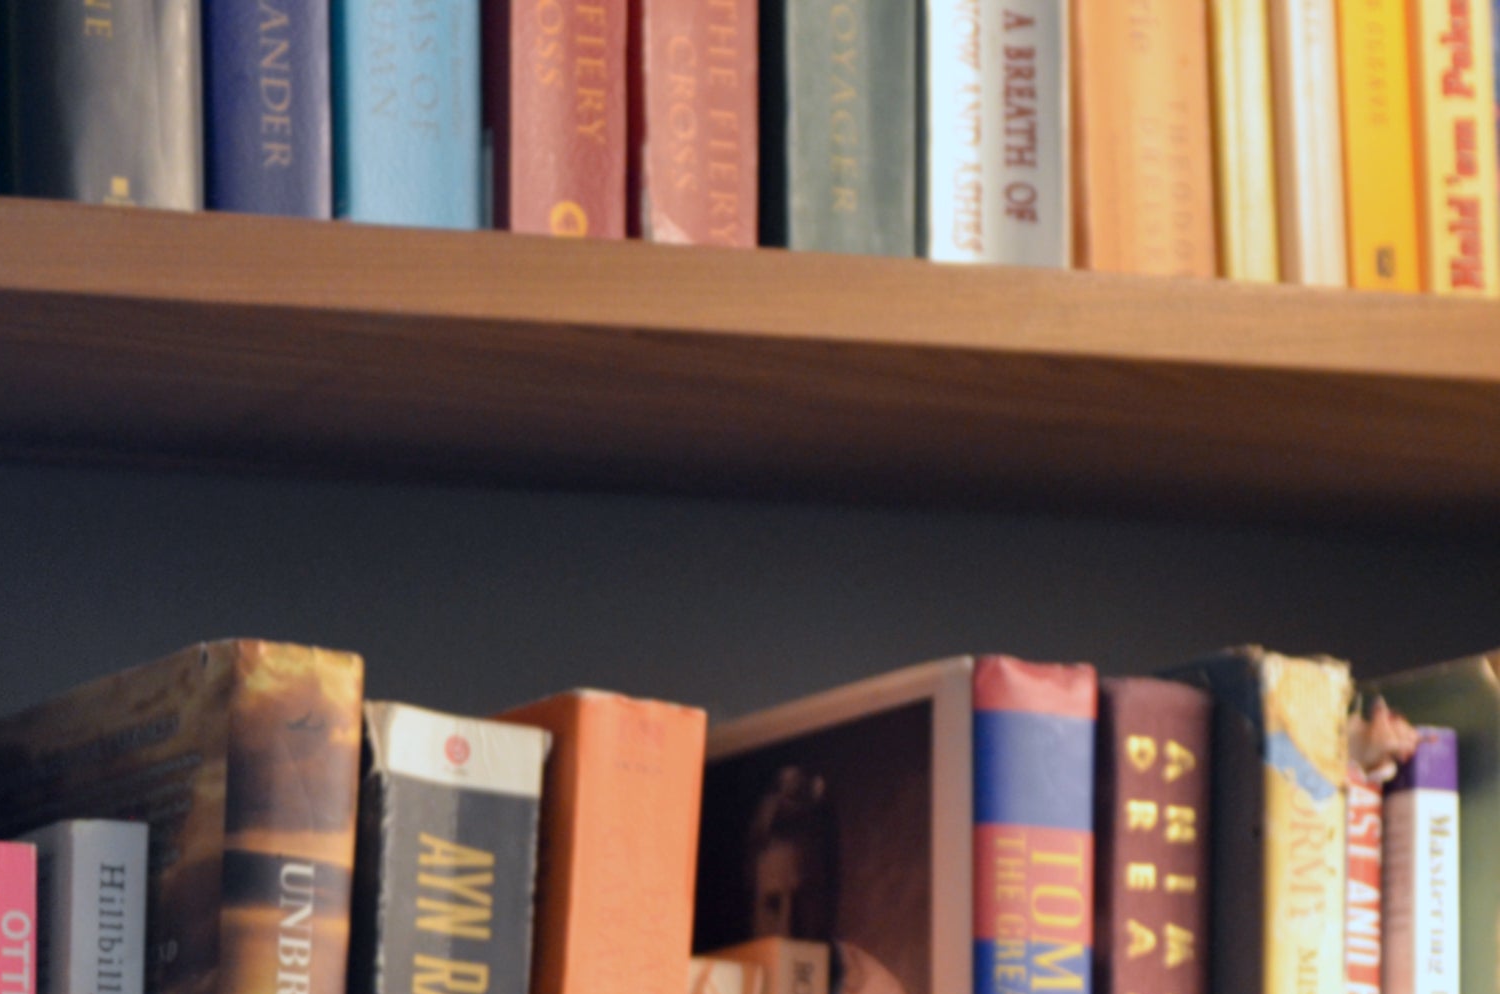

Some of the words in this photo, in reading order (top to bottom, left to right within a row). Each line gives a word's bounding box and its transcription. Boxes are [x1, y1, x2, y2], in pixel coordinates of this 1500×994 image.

[258, 0, 294, 168] ANDER
[574, 3, 608, 146] FIERY
[708, 0, 740, 88] THE
[1003, 9, 1037, 32] A
[667, 34, 699, 193] CROSS
[829, 0, 860, 214] OYAGER
[1003, 44, 1039, 170] BREATH
[708, 107, 741, 248] FIERY
[1003, 181, 1040, 225] OF
[414, 831, 497, 941] AYN
[1347, 780, 1382, 865] AST
[1028, 837, 1088, 993] TOM
